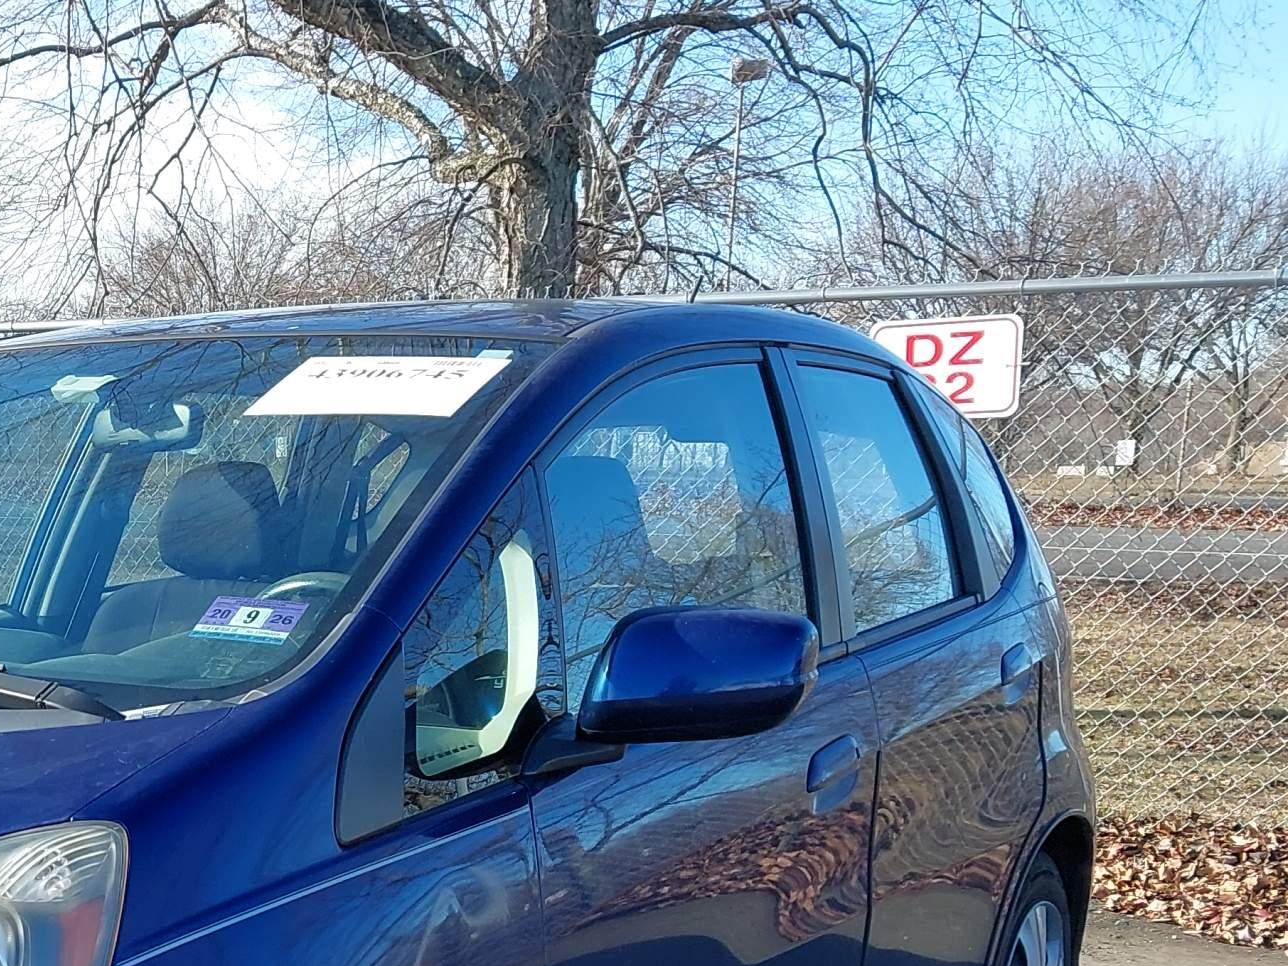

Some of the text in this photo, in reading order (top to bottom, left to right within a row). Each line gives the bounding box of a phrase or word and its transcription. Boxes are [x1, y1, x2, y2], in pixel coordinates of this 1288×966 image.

[906, 330, 984, 368] DZ
[308, 368, 470, 380] 43906745
[923, 371, 975, 404] 2
[209, 608, 294, 626] 20 9 26
